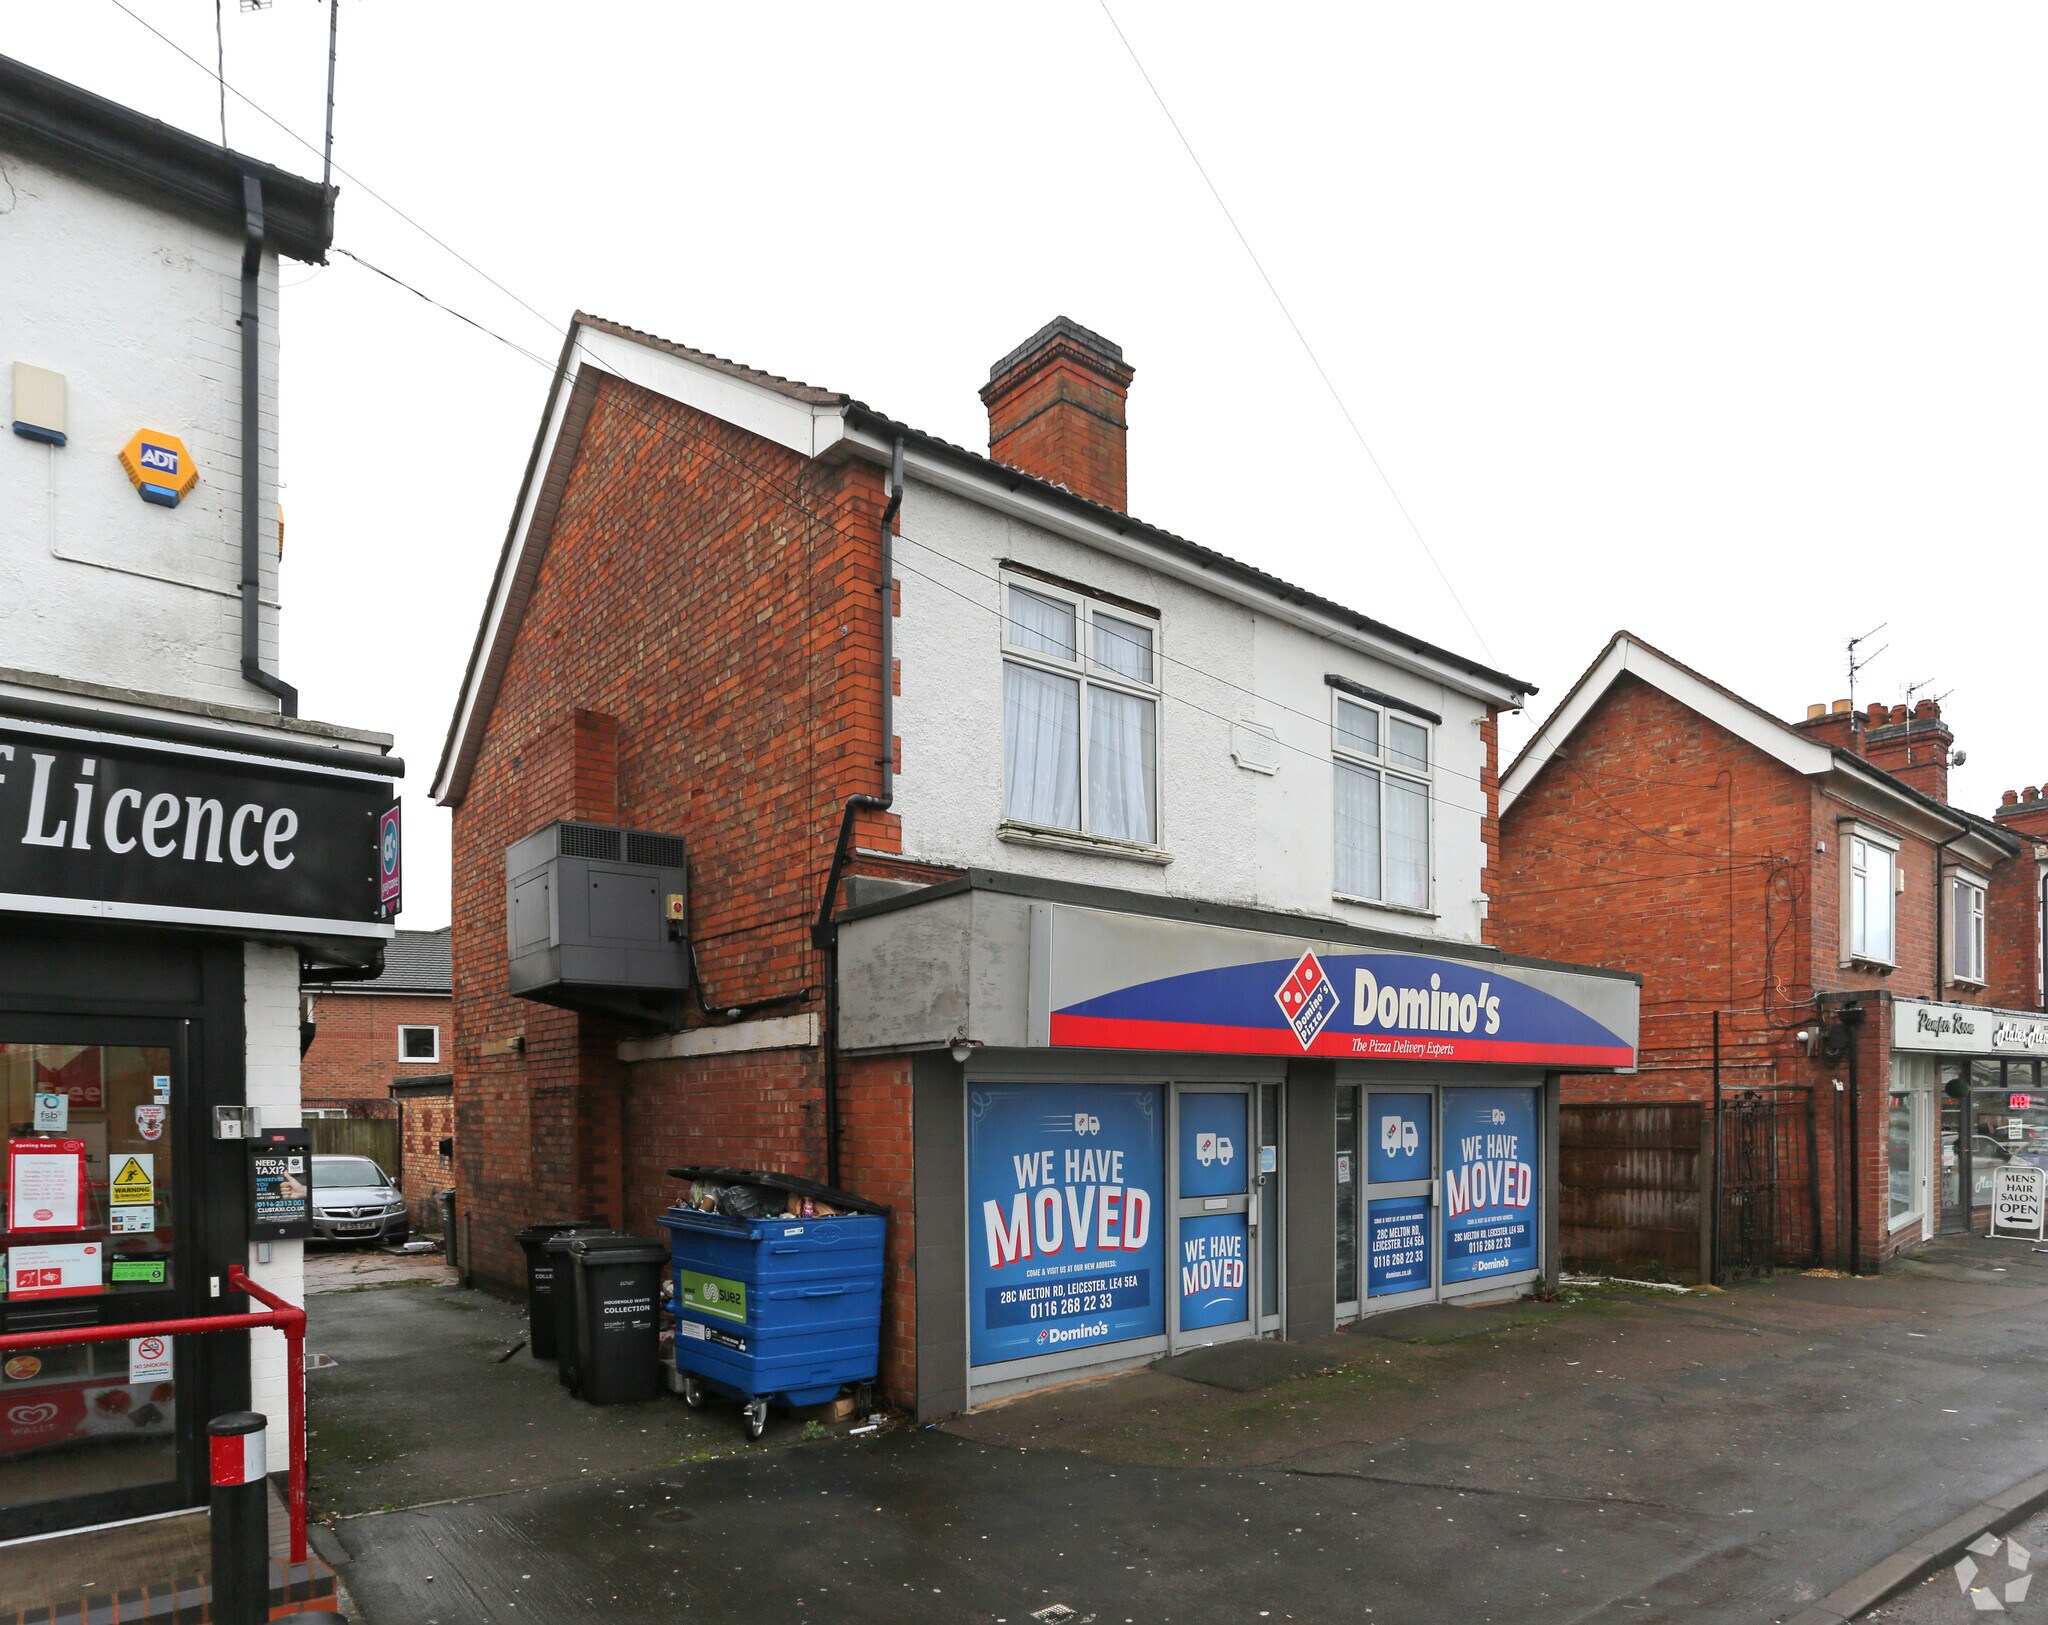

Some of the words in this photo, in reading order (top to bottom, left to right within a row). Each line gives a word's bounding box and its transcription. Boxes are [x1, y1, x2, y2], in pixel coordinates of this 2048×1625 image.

[141, 448, 178, 470] ADT
[22, 753, 298, 870] Licence
[1295, 985, 1329, 1032] Domino's
[1353, 968, 1500, 1034] Domino's
[1301, 1011, 1323, 1042] Pizza
[1352, 1038, 1367, 1052] The
[1368, 1039, 1391, 1053] Pizza
[1392, 1040, 1425, 1057] Delivery
[1427, 1041, 1454, 1057] Experts
[2010, 1095, 2030, 1108] OPEN
[40, 1111, 58, 1119] fsb
[1461, 1137, 1482, 1163] WE
[1487, 1134, 1518, 1160] HAVE
[256, 1166, 285, 1175] TAXI?
[1013, 1150, 1055, 1190] WE
[1065, 1149, 1124, 1184] HAVE
[2005, 1174, 2036, 1183] MENS
[1446, 1160, 1531, 1218] MOVED
[2006, 1184, 2033, 1193] HAIR
[2001, 1193, 2038, 1203] SALON
[2000, 1203, 2038, 1215] OPEN
[983, 1185, 1151, 1269] MOVED
[1377, 1229, 1388, 1240] 28C
[1389, 1226, 1410, 1238] MELTON
[1412, 1225, 1420, 1236] RD,
[1454, 1233, 1463, 1242] 28C
[1463, 1231, 1479, 1241] MELTON
[1487, 1226, 1508, 1237] LEICESTER.
[1516, 1224, 1524, 1234] 5EA
[1185, 1237, 1206, 1263] WE
[1210, 1236, 1242, 1258] HAVE
[1372, 1238, 1402, 1252] LEICESTER.
[1403, 1236, 1413, 1248] LE4
[1414, 1235, 1424, 1246] 5EA
[1468, 1241, 1483, 1254] 0116
[1484, 1239, 1495, 1251] 268
[1496, 1238, 1503, 1249] 22
[1504, 1237, 1511, 1248] 33
[1373, 1254, 1391, 1268] 0116
[1391, 1252, 1404, 1266] 268
[1405, 1251, 1414, 1264] 22
[1415, 1250, 1423, 1262] 33
[1478, 1256, 1509, 1271] Domino's
[1026, 1268, 1040, 1278] COME
[1042, 1267, 1046, 1275] &
[1047, 1265, 1059, 1275] VISIT
[1060, 1265, 1067, 1274] US
[1067, 1264, 1073, 1273] AT
[1074, 1263, 1083, 1272] OUR
[1084, 1262, 1095, 1271] NEW
[1096, 1260, 1117, 1270] ADDRESS:
[1182, 1259, 1244, 1297] MOVED
[1385, 1268, 1412, 1279] dominos.co.uk
[719, 1289, 741, 1305] suez
[1000, 1291, 1017, 1304] 28C
[1019, 1286, 1050, 1302] MELTON
[1053, 1286, 1065, 1298] RD,
[1067, 1280, 1107, 1295] LEICESTER.
[1109, 1278, 1122, 1289] LE4
[1124, 1275, 1138, 1288] 5EA
[604, 1305, 650, 1314] COLLECTION
[1030, 1301, 1057, 1319] 0116
[1060, 1297, 1080, 1315] 268
[1083, 1295, 1096, 1312] 22
[1099, 1293, 1112, 1309] 33
[1050, 1320, 1108, 1344] Domino's
[11, 1423, 55, 1435] WALL'S
